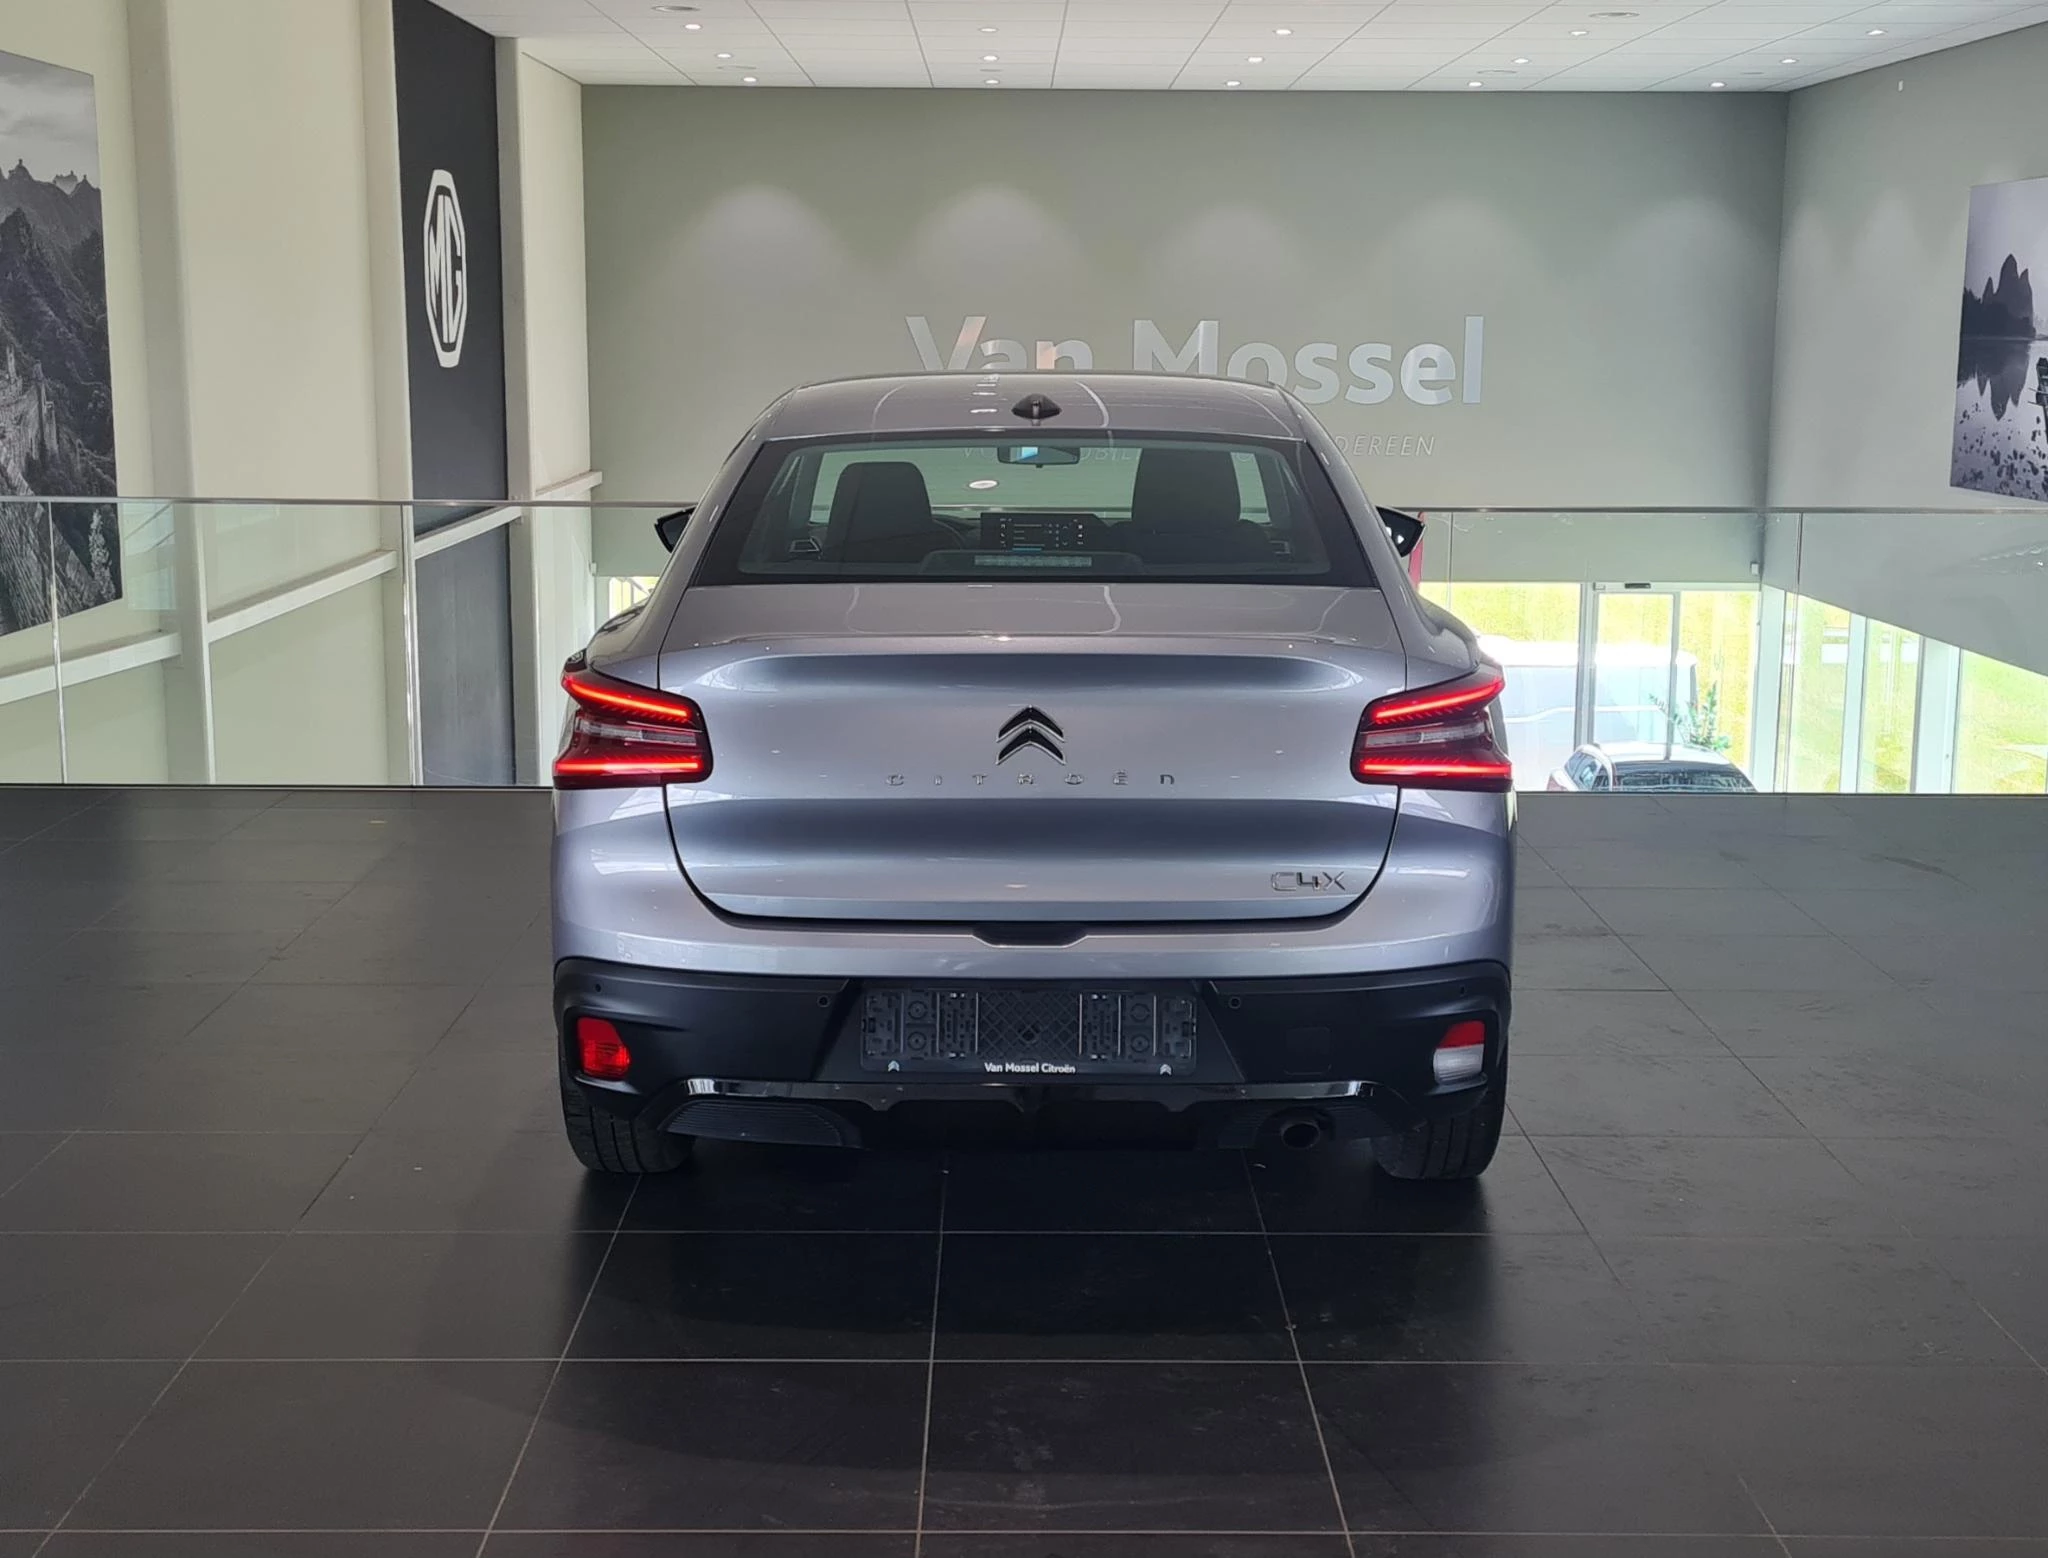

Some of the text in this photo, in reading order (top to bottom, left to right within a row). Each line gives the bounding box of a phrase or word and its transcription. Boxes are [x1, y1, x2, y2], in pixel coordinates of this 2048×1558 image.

[428, 194, 463, 344] MG
[904, 314, 1485, 405] Van Mossel
[984, 1062, 1076, 1074] Van Mossel Citroën
